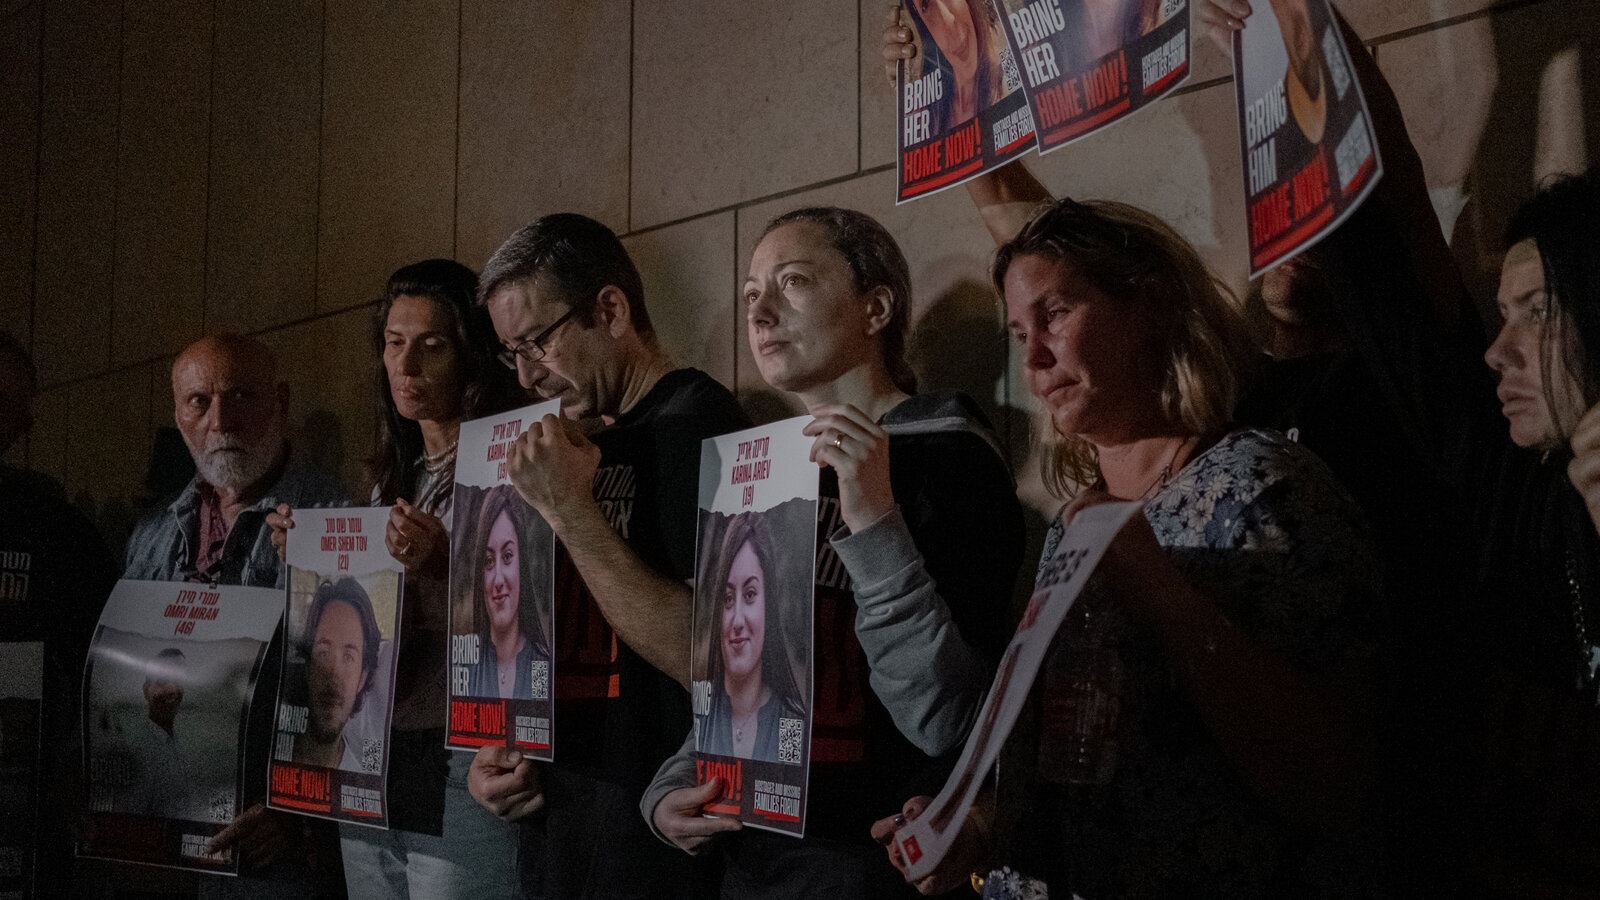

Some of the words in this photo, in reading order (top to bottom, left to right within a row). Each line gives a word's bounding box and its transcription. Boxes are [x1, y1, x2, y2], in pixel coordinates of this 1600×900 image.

[1008, 0, 1066, 49] BRING
[1021, 42, 1060, 88] HER
[904, 68, 943, 114] BRING
[1035, 77, 1083, 130] HOME
[1082, 49, 1128, 110] NOW!
[904, 109, 931, 148] HER
[1246, 78, 1287, 149] BRING
[904, 140, 942, 184] HOME
[945, 117, 982, 169] NOW!
[994, 124, 1018, 151] FAMILIES
[1248, 137, 1277, 198] HIM
[1251, 182, 1292, 248] HOME
[1292, 143, 1331, 222] NOW!
[487, 442, 506, 462] KARINA
[497, 462, 508, 481] (19)
[731, 463, 752, 485] KARINA
[753, 459, 772, 481] ARIEV
[742, 484, 755, 508] (19)
[320, 535, 337, 552] OMER
[338, 535, 355, 552] SHEM
[355, 535, 368, 552] TOV
[337, 553, 350, 571] (21)
[163, 604, 189, 619] OMRI
[188, 606, 220, 621] MIRAN
[175, 590, 197, 605] מירן
[198, 591, 220, 606] עמרי
[174, 620, 196, 636] (46)
[452, 633, 480, 665] BRING
[452, 666, 470, 697] HER
[278, 703, 310, 734] BRING
[451, 701, 478, 733] HOME
[478, 700, 506, 736] NOW!
[272, 765, 300, 797] HOME
[301, 768, 331, 802] NOW!
[754, 792, 780, 814] FAMILIES
[780, 796, 801, 818] FORUM
